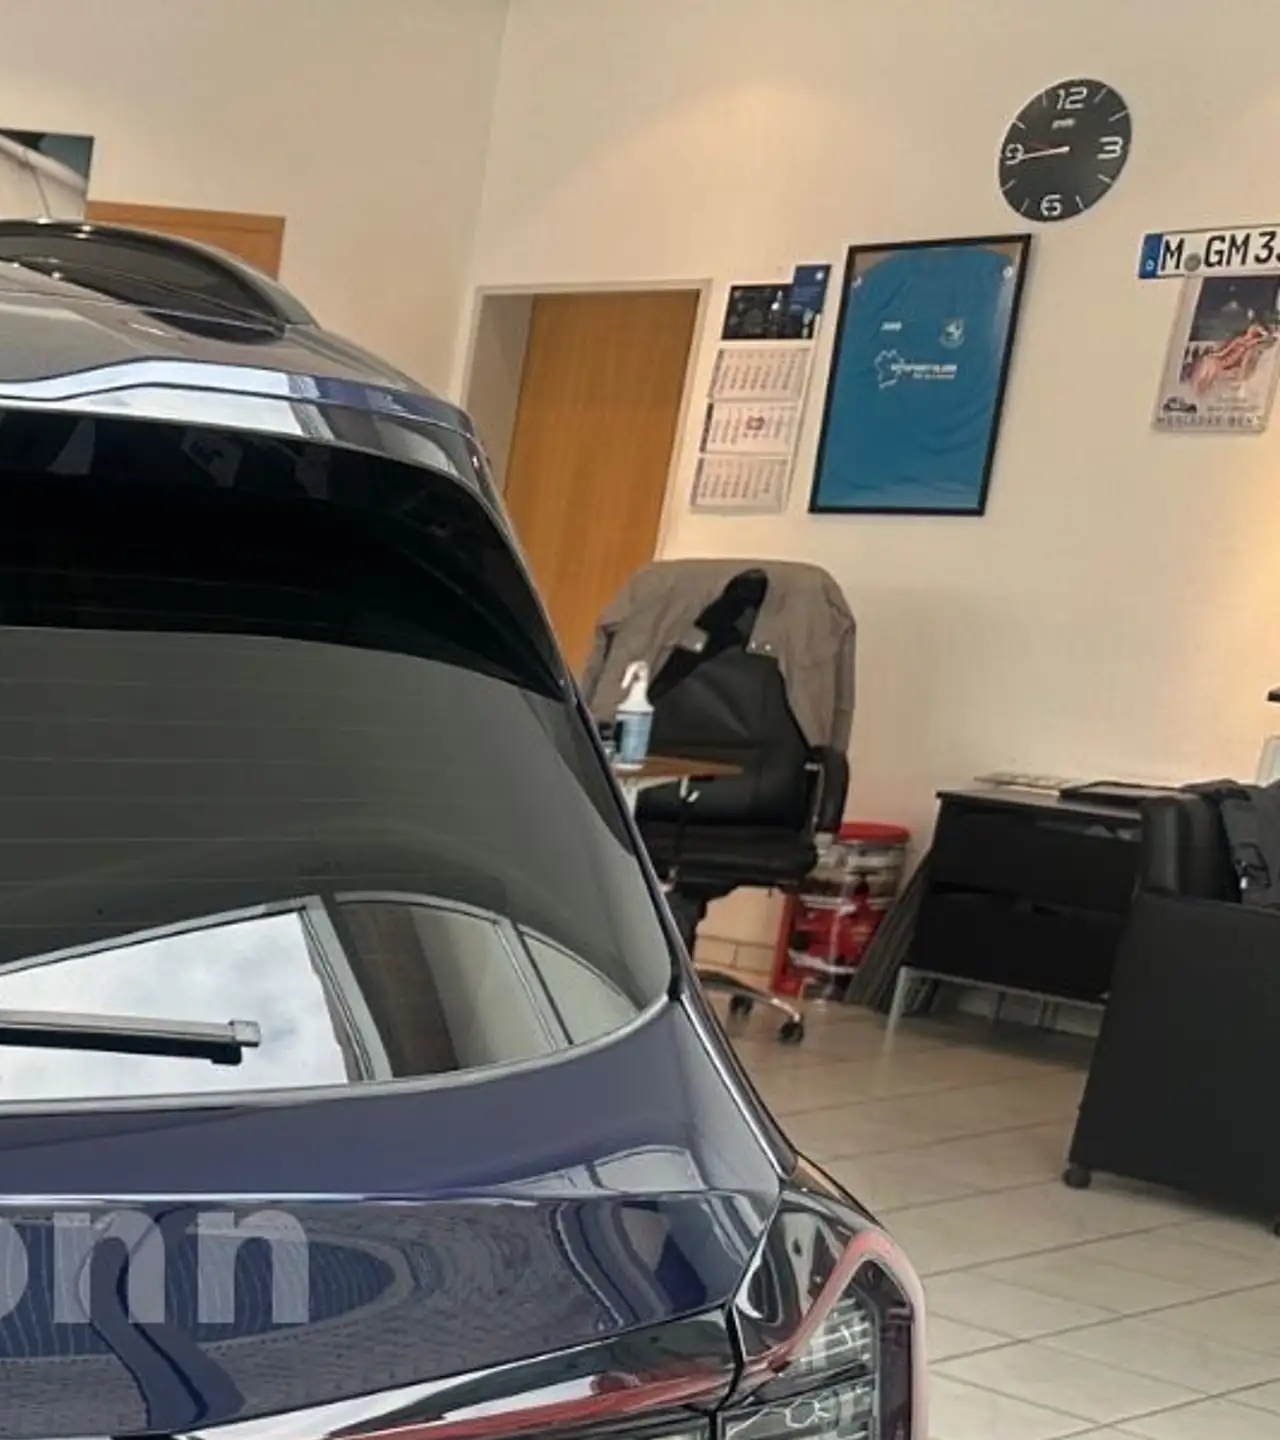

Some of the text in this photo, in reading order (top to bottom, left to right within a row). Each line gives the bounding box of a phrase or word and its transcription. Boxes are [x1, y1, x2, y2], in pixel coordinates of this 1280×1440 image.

[1056, 86, 1088, 109] 12
[1096, 136, 1123, 159] 3
[1040, 194, 1063, 217] 6
[1161, 237, 1185, 270] M
[1203, 232, 1251, 267] GM
